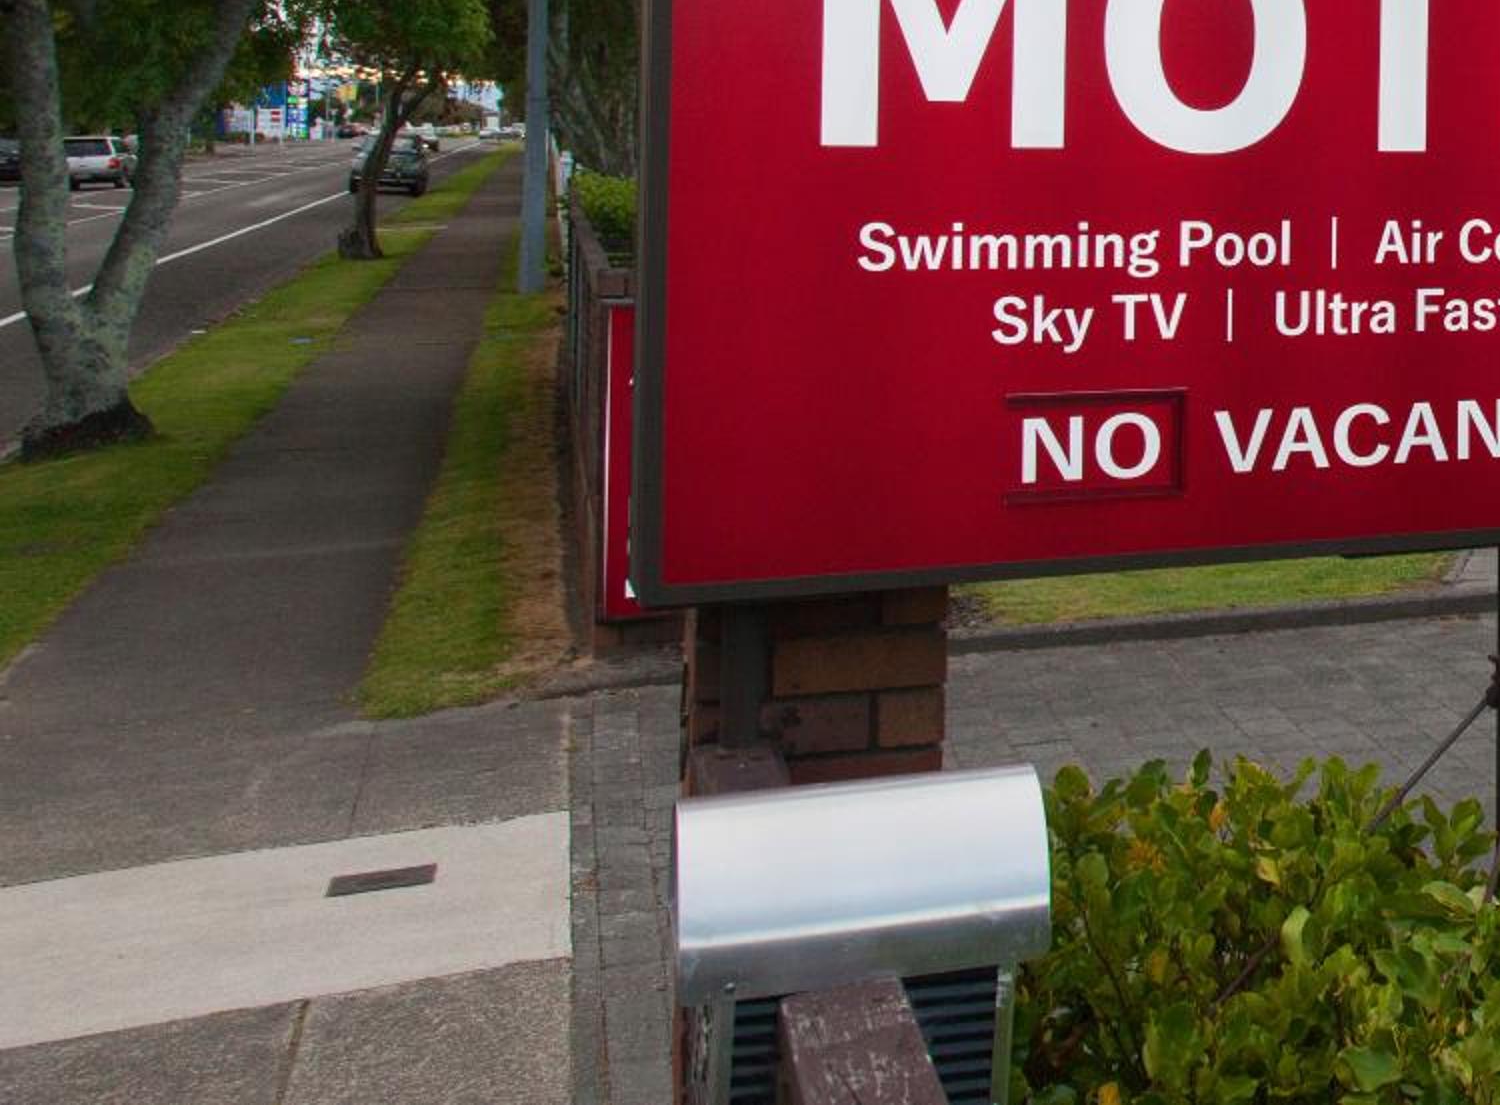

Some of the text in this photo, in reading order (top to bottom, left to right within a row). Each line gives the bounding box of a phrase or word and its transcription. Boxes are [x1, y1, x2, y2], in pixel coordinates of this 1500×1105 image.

[857, 221, 1160, 278] Swimming
[1179, 219, 1291, 267] Pool
[1374, 219, 1444, 264] Air
[991, 294, 1094, 354] Sky
[1111, 292, 1187, 340] TV
[1275, 289, 1396, 336] Ultra
[1021, 412, 1161, 484] NO
